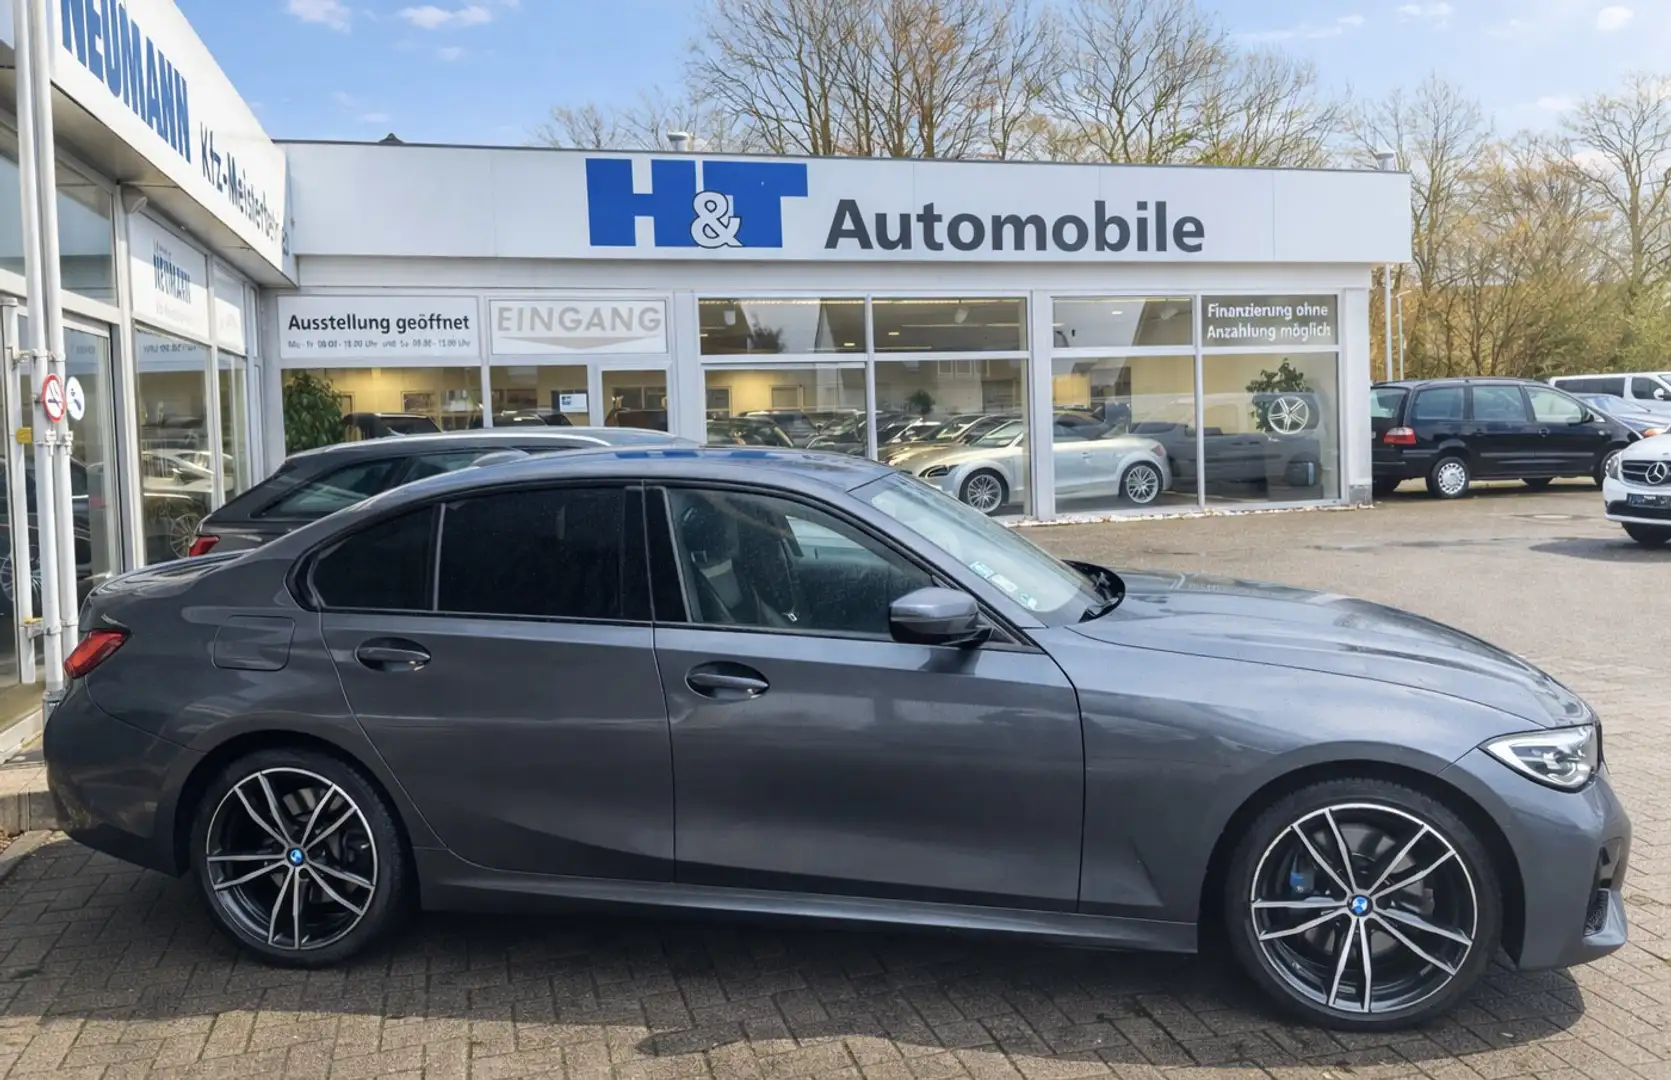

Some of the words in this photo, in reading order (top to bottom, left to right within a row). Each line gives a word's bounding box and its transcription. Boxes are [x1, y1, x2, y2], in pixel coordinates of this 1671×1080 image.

[585, 158, 808, 249] H&T
[824, 199, 1205, 252] Automobile
[497, 306, 661, 332] EINGANG
[1207, 303, 1292, 321] Finanzierung
[1296, 301, 1329, 317] ohne
[288, 314, 390, 334] Ausstellung
[395, 313, 470, 334] geöffnet
[1207, 323, 1276, 341] Anzahlung
[1280, 322, 1331, 342] möglich
